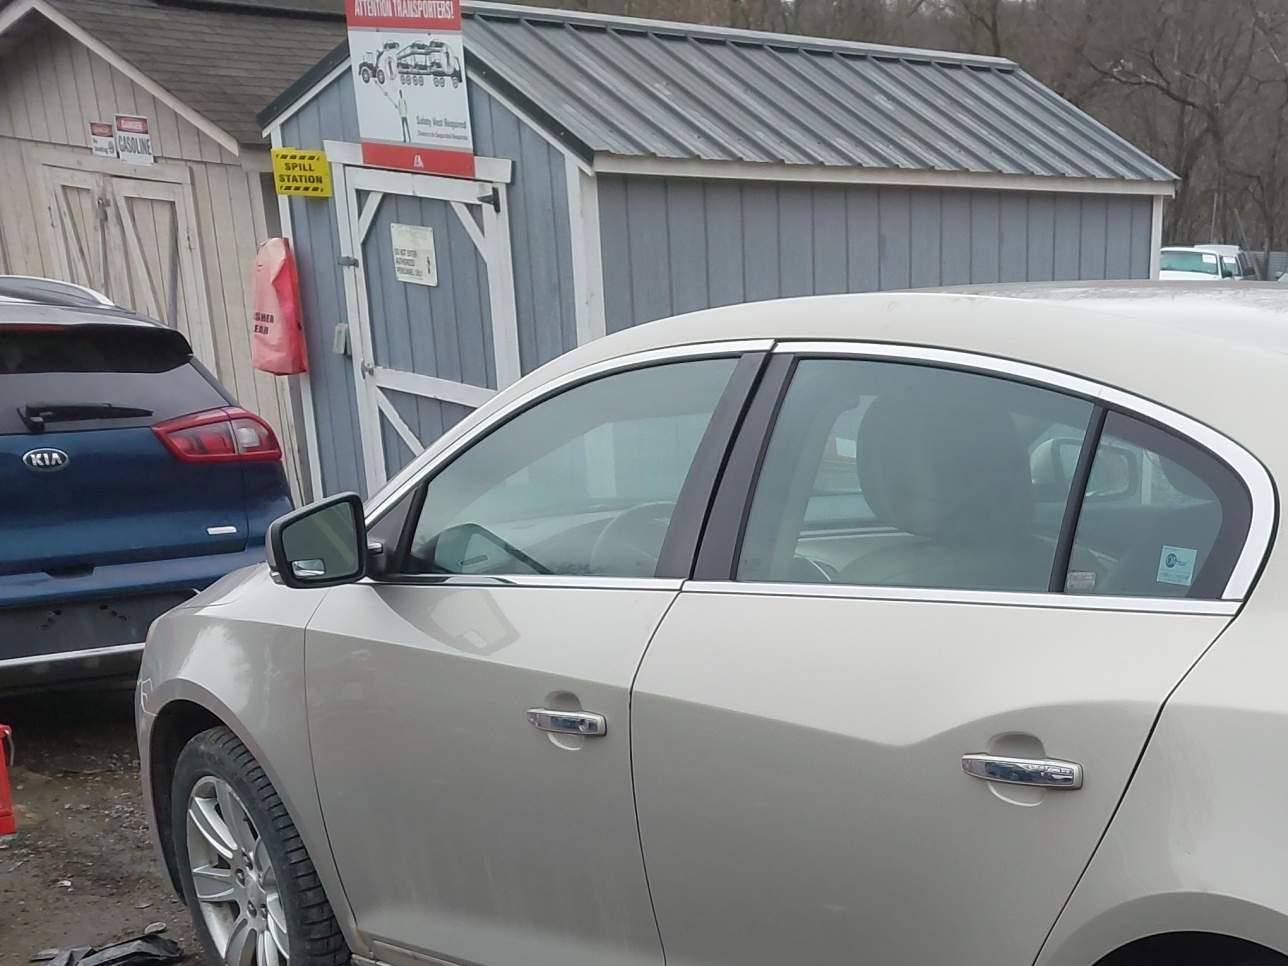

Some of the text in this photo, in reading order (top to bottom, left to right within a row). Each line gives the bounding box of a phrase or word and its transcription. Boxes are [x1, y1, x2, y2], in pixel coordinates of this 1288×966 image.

[354, 0, 455, 19] ATTENTION TRANSPORTERS!
[118, 135, 152, 155] GASOLINE
[284, 162, 315, 171] SPILL
[278, 174, 323, 184] STATION
[30, 453, 63, 466] KIA
